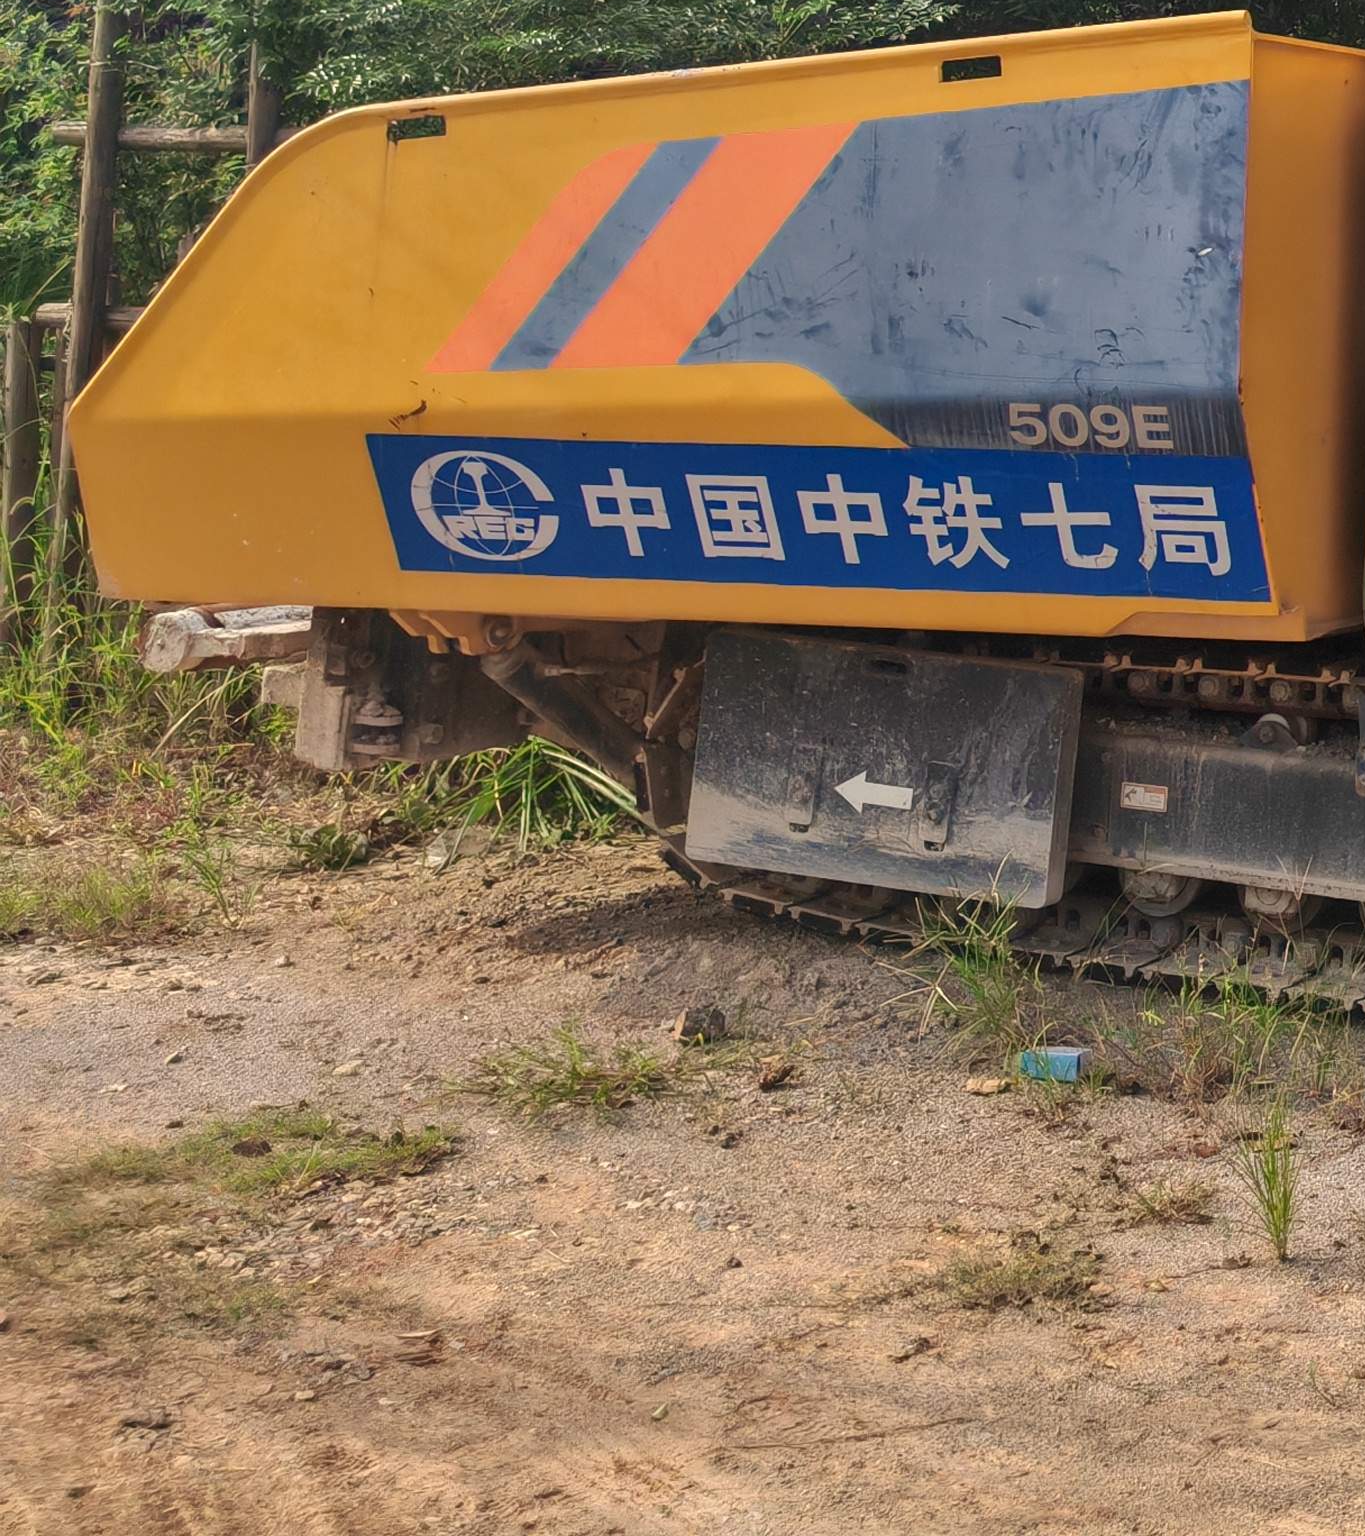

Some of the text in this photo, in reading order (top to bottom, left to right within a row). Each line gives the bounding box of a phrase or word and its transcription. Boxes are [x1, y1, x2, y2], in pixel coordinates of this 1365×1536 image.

[1006, 403, 1174, 451] 509E
[580, 467, 1234, 577] 中国中铁七局
